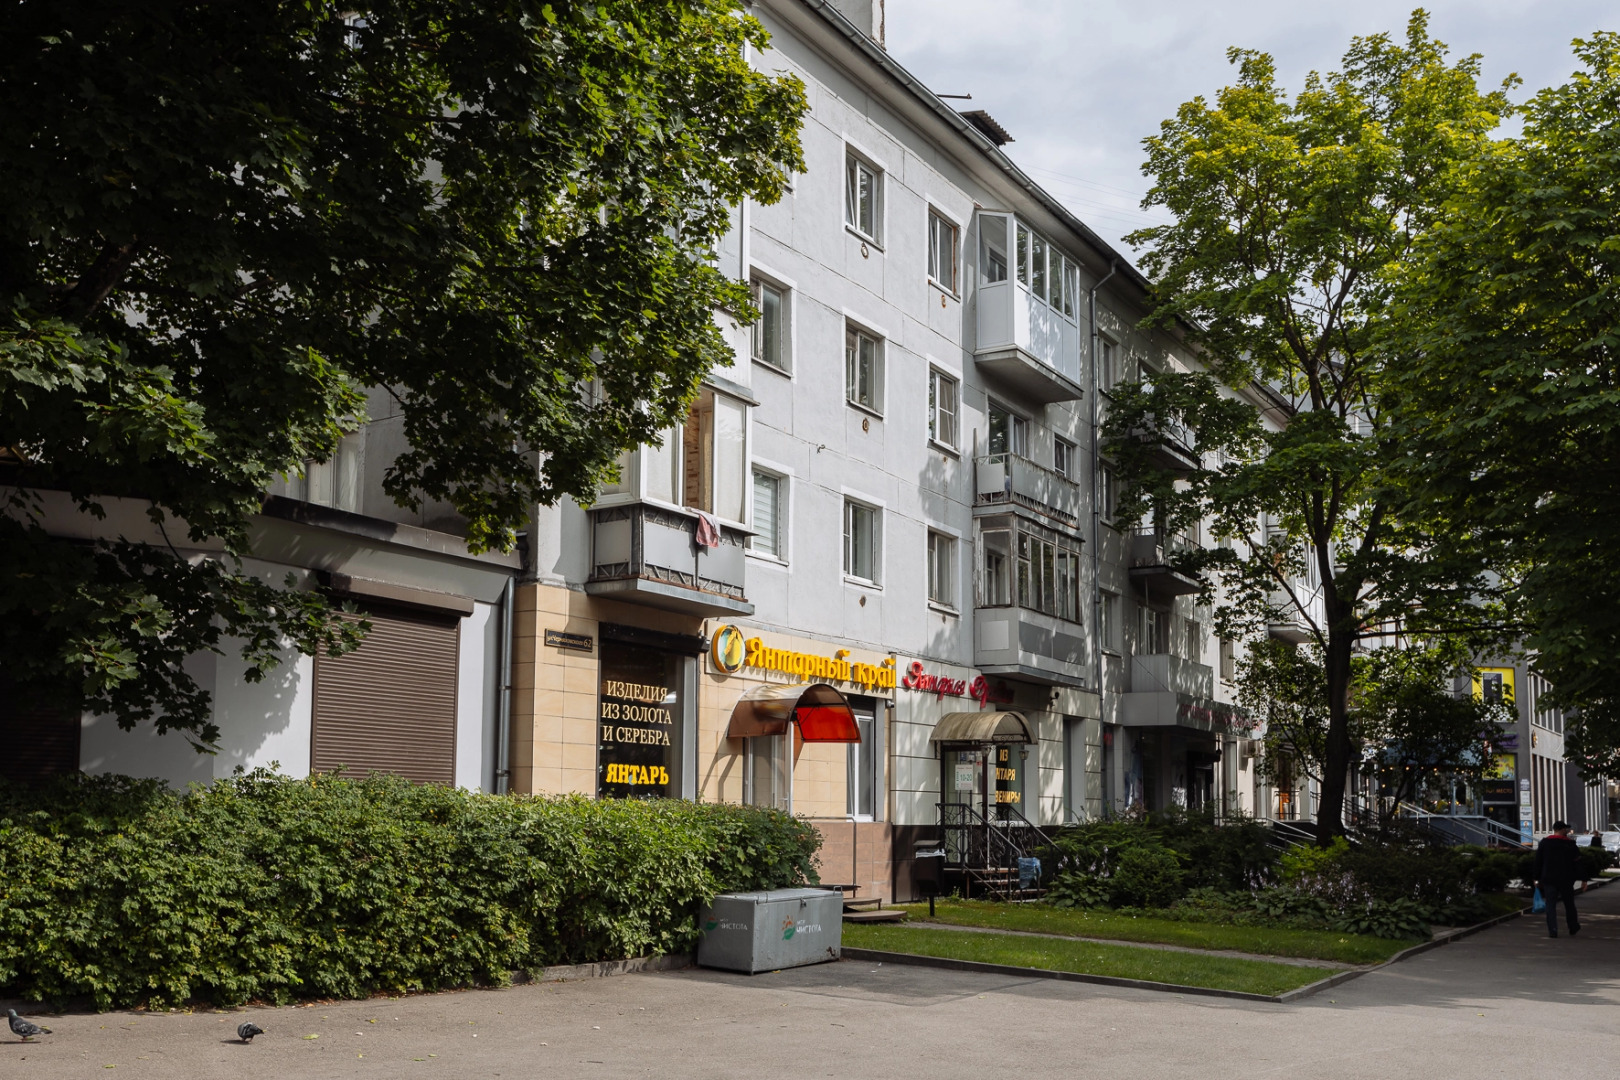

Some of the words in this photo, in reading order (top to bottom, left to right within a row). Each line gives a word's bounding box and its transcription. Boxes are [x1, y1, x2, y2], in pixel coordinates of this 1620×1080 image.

[583, 638, 592, 648] 62
[745, 637, 851, 681] Янтарный
[853, 658, 896, 690] край
[606, 680, 668, 701] ИЗДЕЛИЯ
[602, 702, 620, 719] ИЗ
[622, 705, 672, 725] ЗОЛОТА
[603, 725, 613, 741] И
[616, 726, 671, 746] СЕРЕБРА
[999, 749, 1009, 762] ИЗ
[606, 763, 669, 785] ЯНТАРЬ
[996, 768, 1016, 781] НТАРЯ
[995, 790, 1021, 804] ВЕНИРЫ
[720, 923, 748, 931] ЧИСТОТА
[797, 924, 822, 934] ЧИСТОТА
